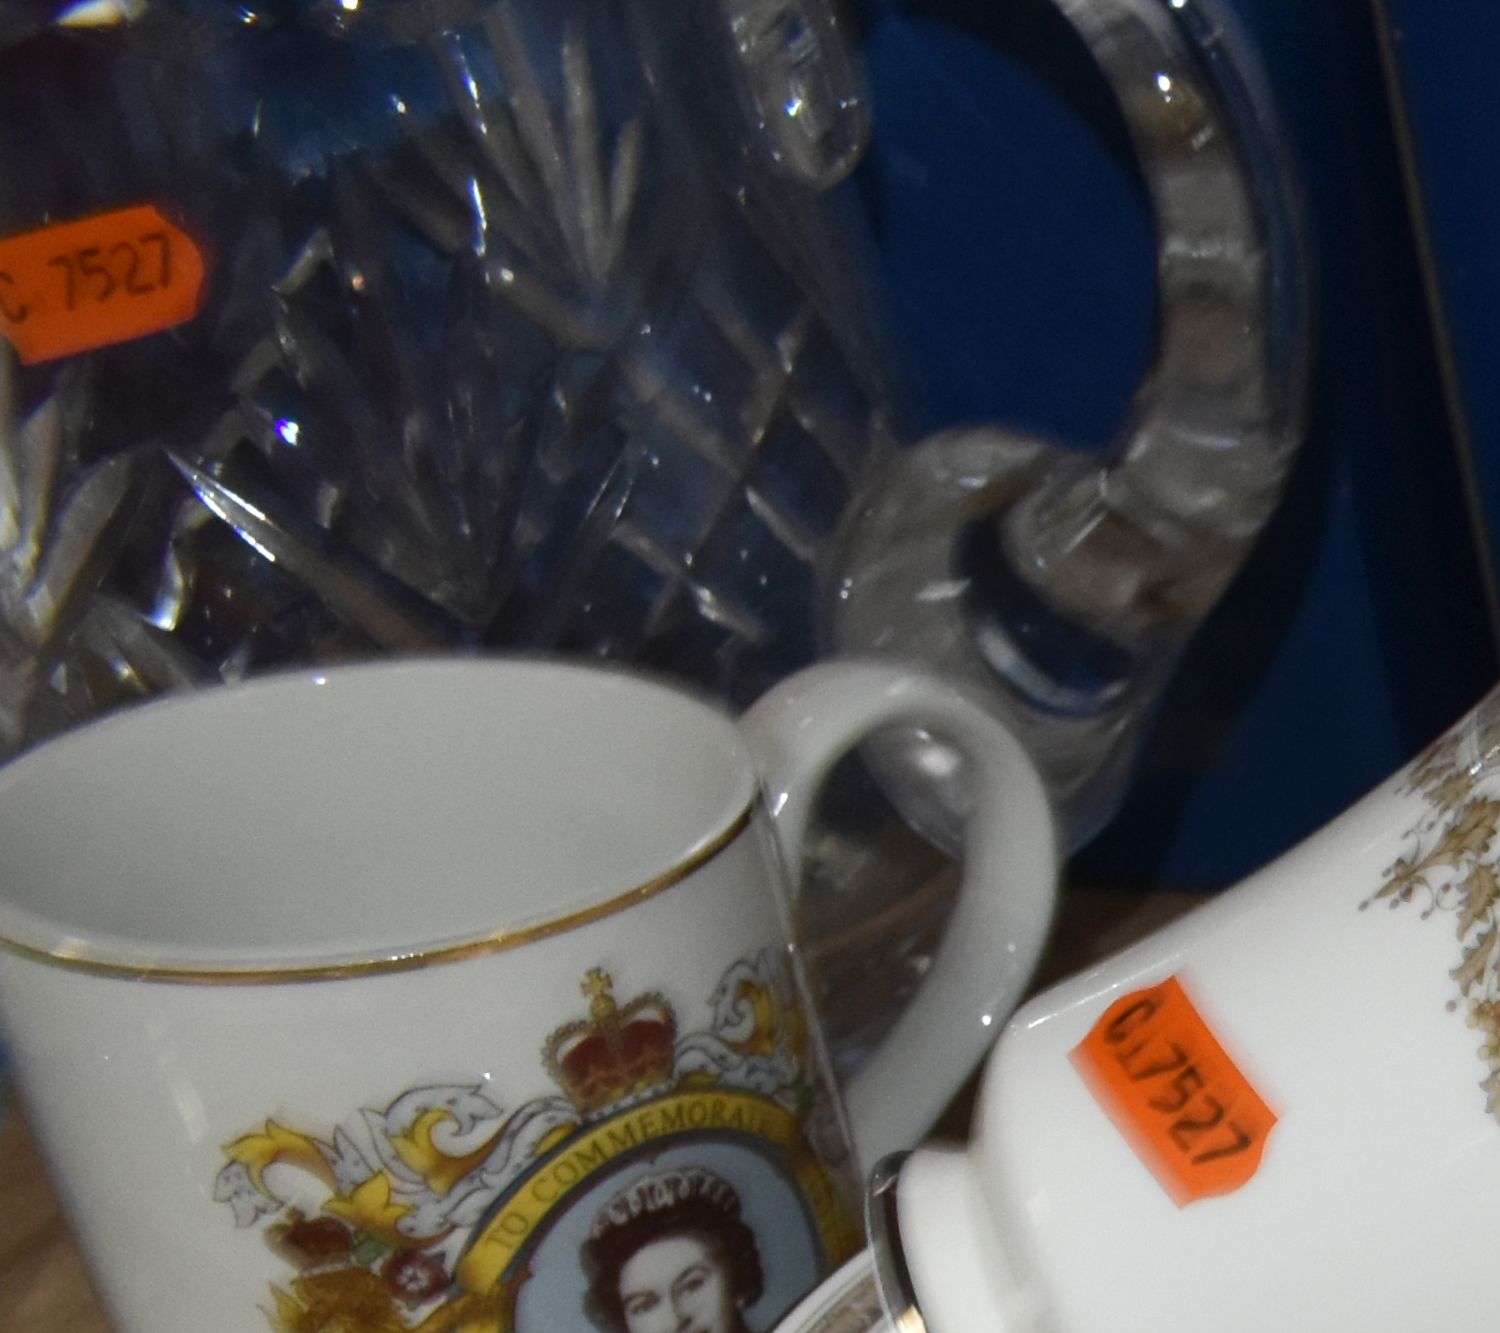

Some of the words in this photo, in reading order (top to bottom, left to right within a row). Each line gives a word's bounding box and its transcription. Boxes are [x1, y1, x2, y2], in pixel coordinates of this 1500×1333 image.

[48, 231, 172, 312] 7527
[1124, 1042, 1253, 1167] 7527
[487, 1211, 530, 1250] TO
